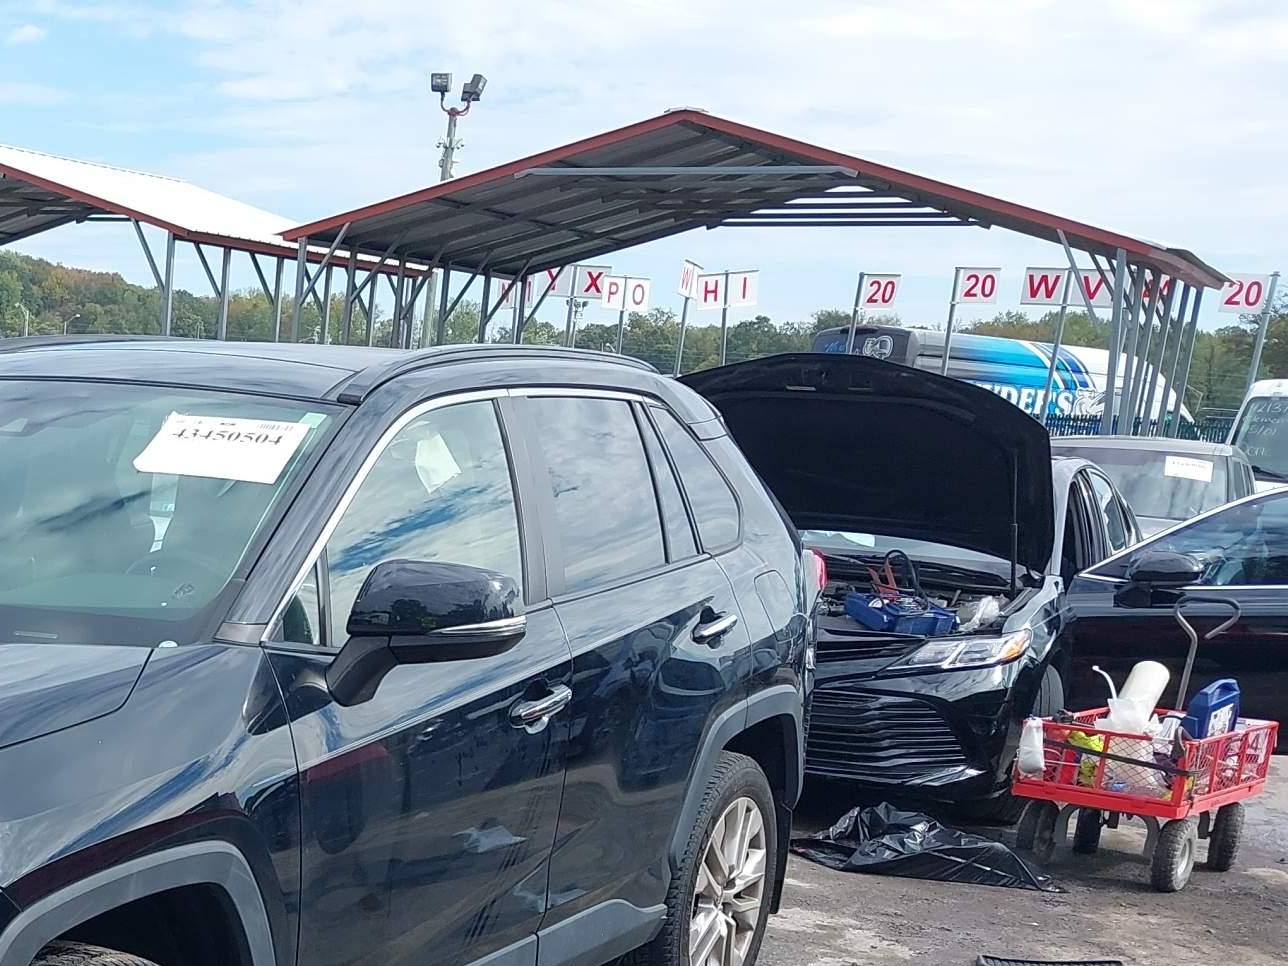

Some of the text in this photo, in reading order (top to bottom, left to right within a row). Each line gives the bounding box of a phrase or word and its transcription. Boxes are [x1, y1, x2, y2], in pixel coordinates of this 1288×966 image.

[584, 271, 604, 293] X
[607, 281, 620, 303] P
[703, 279, 719, 303] H
[866, 280, 896, 304] 20
[963, 274, 996, 298] 20
[1028, 274, 1061, 298] W
[1224, 280, 1263, 306] 20
[172, 428, 283, 446] 43450504
